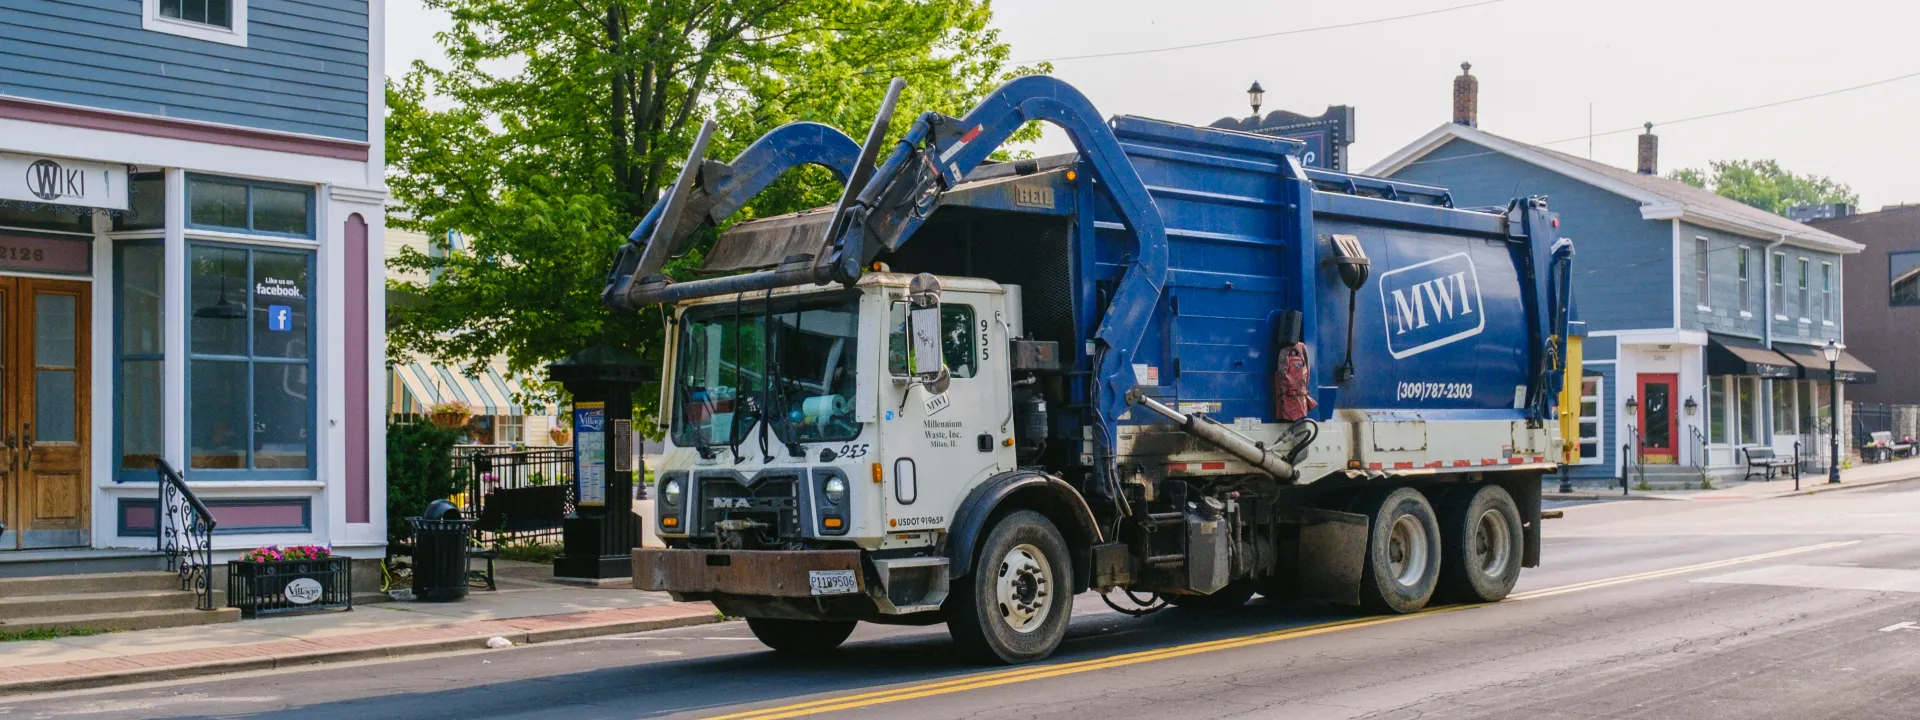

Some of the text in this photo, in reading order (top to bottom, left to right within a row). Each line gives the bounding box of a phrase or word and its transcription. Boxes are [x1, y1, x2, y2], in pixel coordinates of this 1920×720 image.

[34, 163, 85, 199] WIKI
[256, 283, 300, 297] facebook
[1391, 271, 1472, 335] MWI
[1397, 381, 1473, 401] (309)787-2303
[926, 395, 947, 411] MWI
[923, 420, 963, 429] Millennium
[924, 430, 962, 439] Waste, Inc.
[837, 444, 869, 459] 955
[930, 440, 949, 448] Milan,
[898, 517, 919, 526] USDOT
[288, 583, 319, 600] Village
